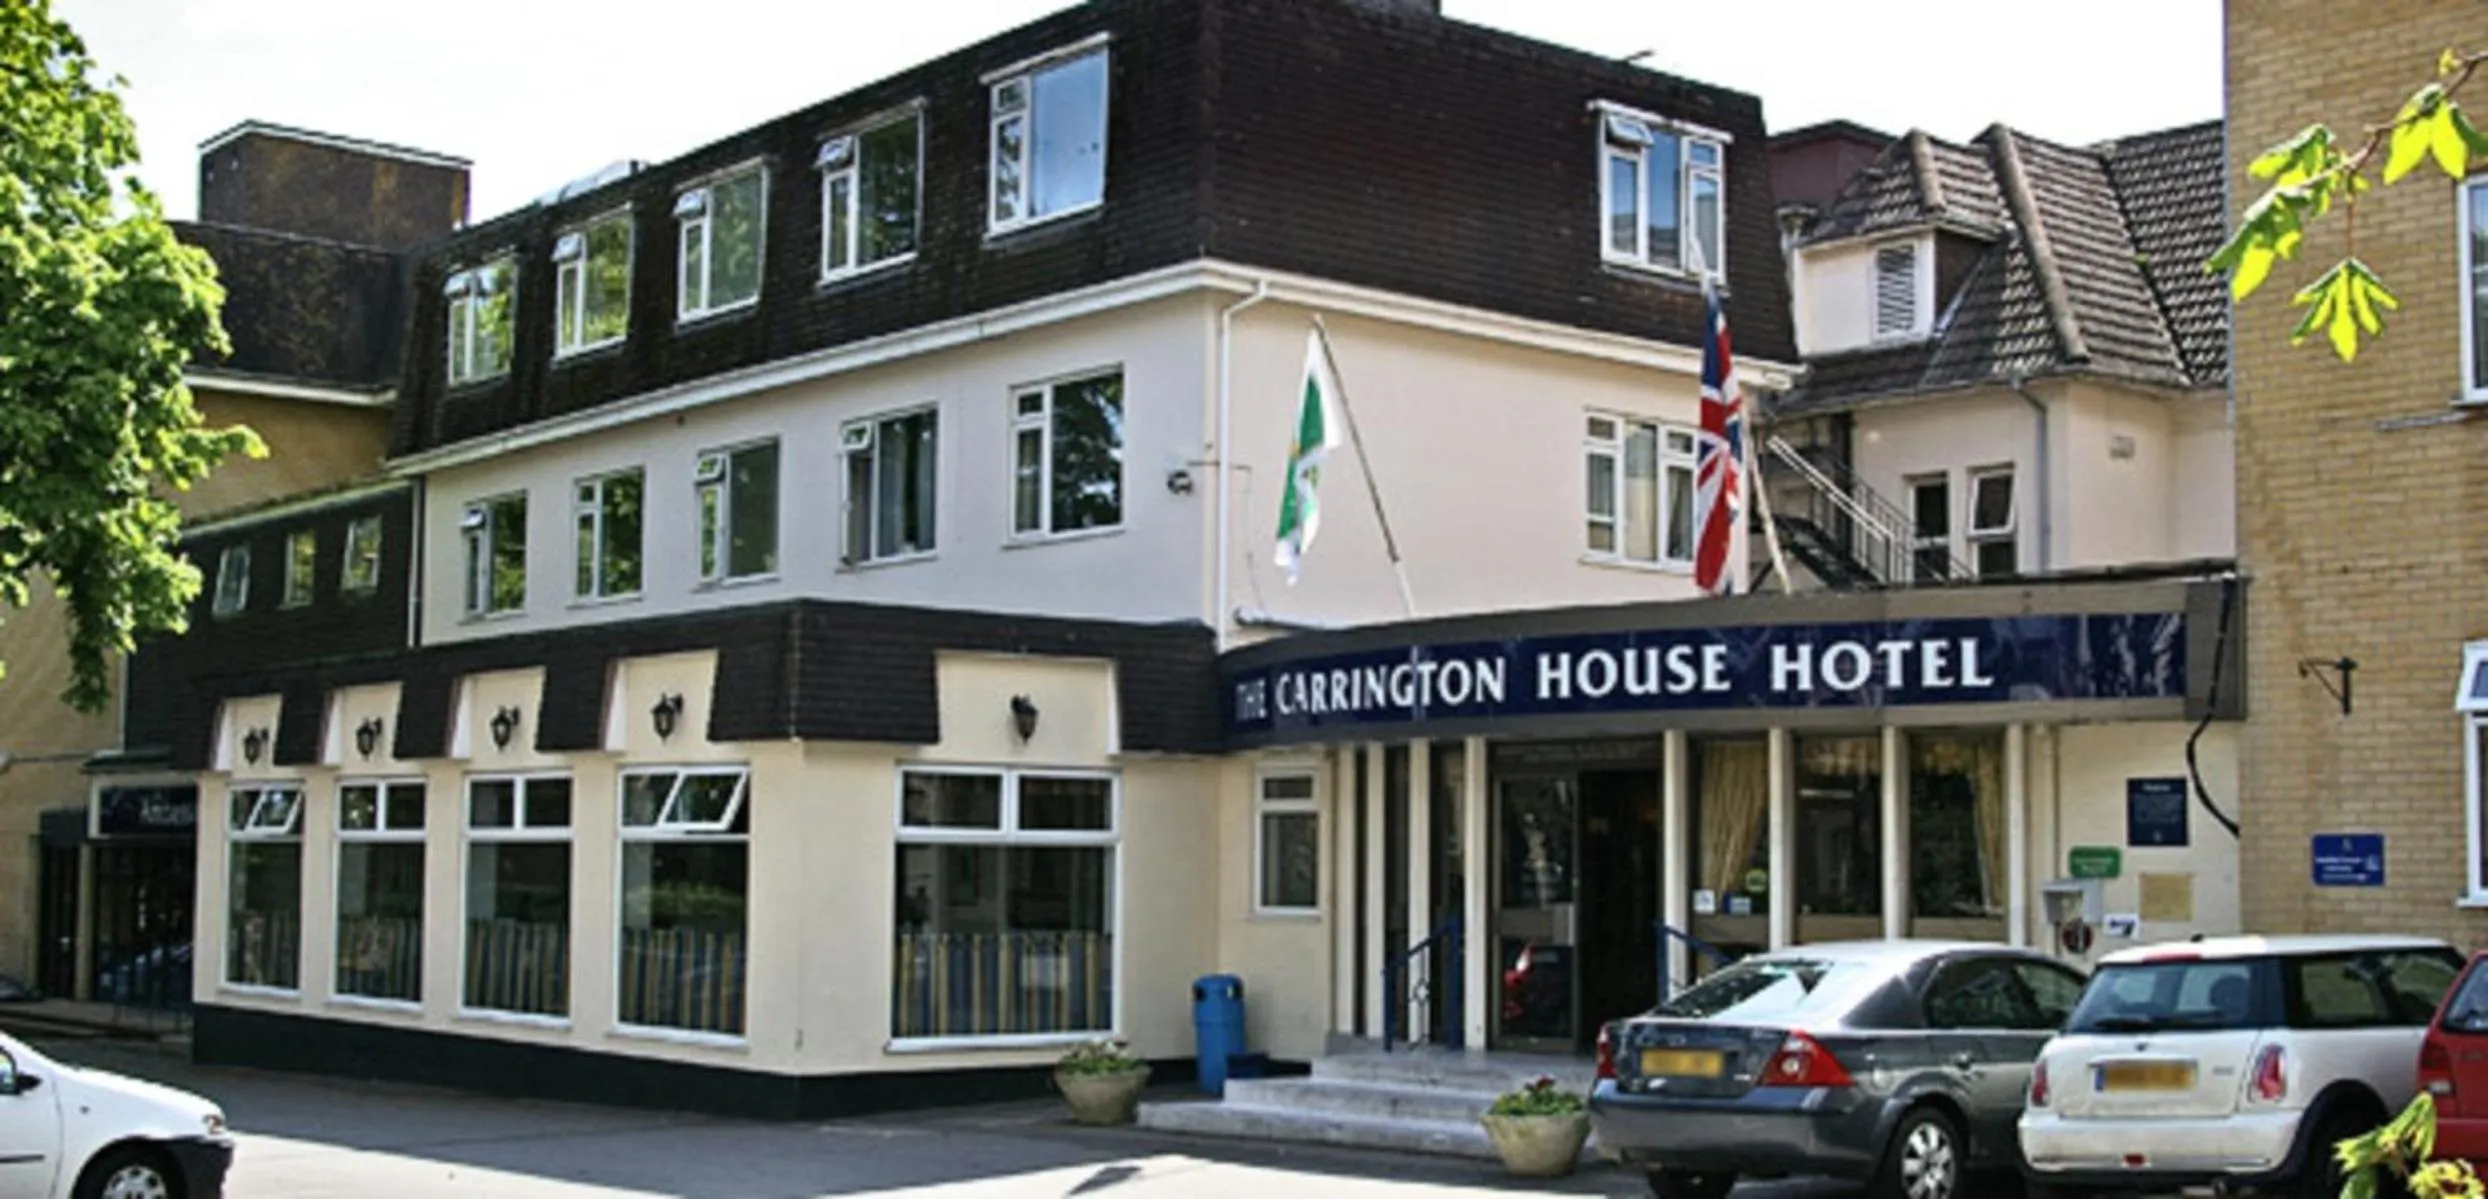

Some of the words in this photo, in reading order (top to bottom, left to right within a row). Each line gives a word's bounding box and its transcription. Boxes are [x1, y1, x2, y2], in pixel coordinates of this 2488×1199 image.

[1275, 656, 1506, 715] CARRINGTON
[1537, 644, 1732, 699] HOUSE
[1771, 638, 1995, 692] HOTEL
